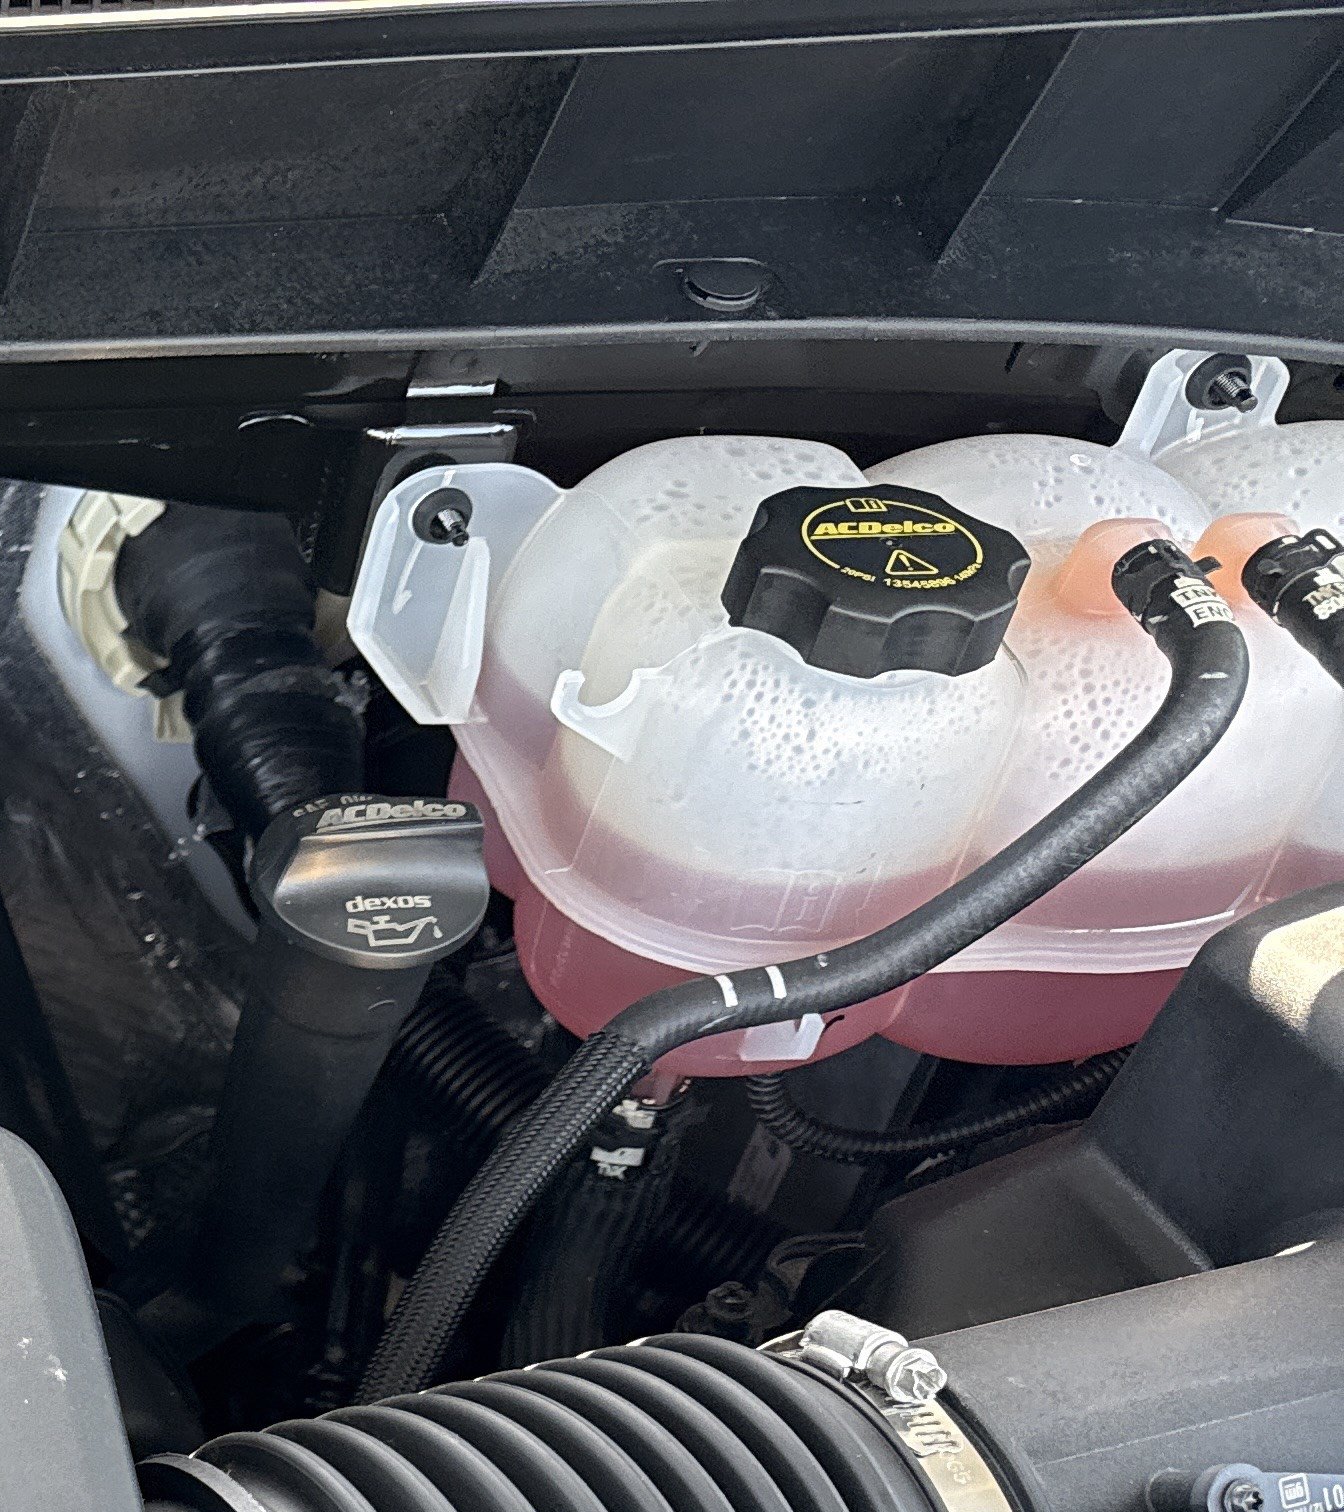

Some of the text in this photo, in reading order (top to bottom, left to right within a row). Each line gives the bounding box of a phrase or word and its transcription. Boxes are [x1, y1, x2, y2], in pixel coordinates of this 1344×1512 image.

[813, 520, 956, 536] ACDelco
[316, 800, 467, 829] ACDelco
[345, 895, 432, 913] dexos
